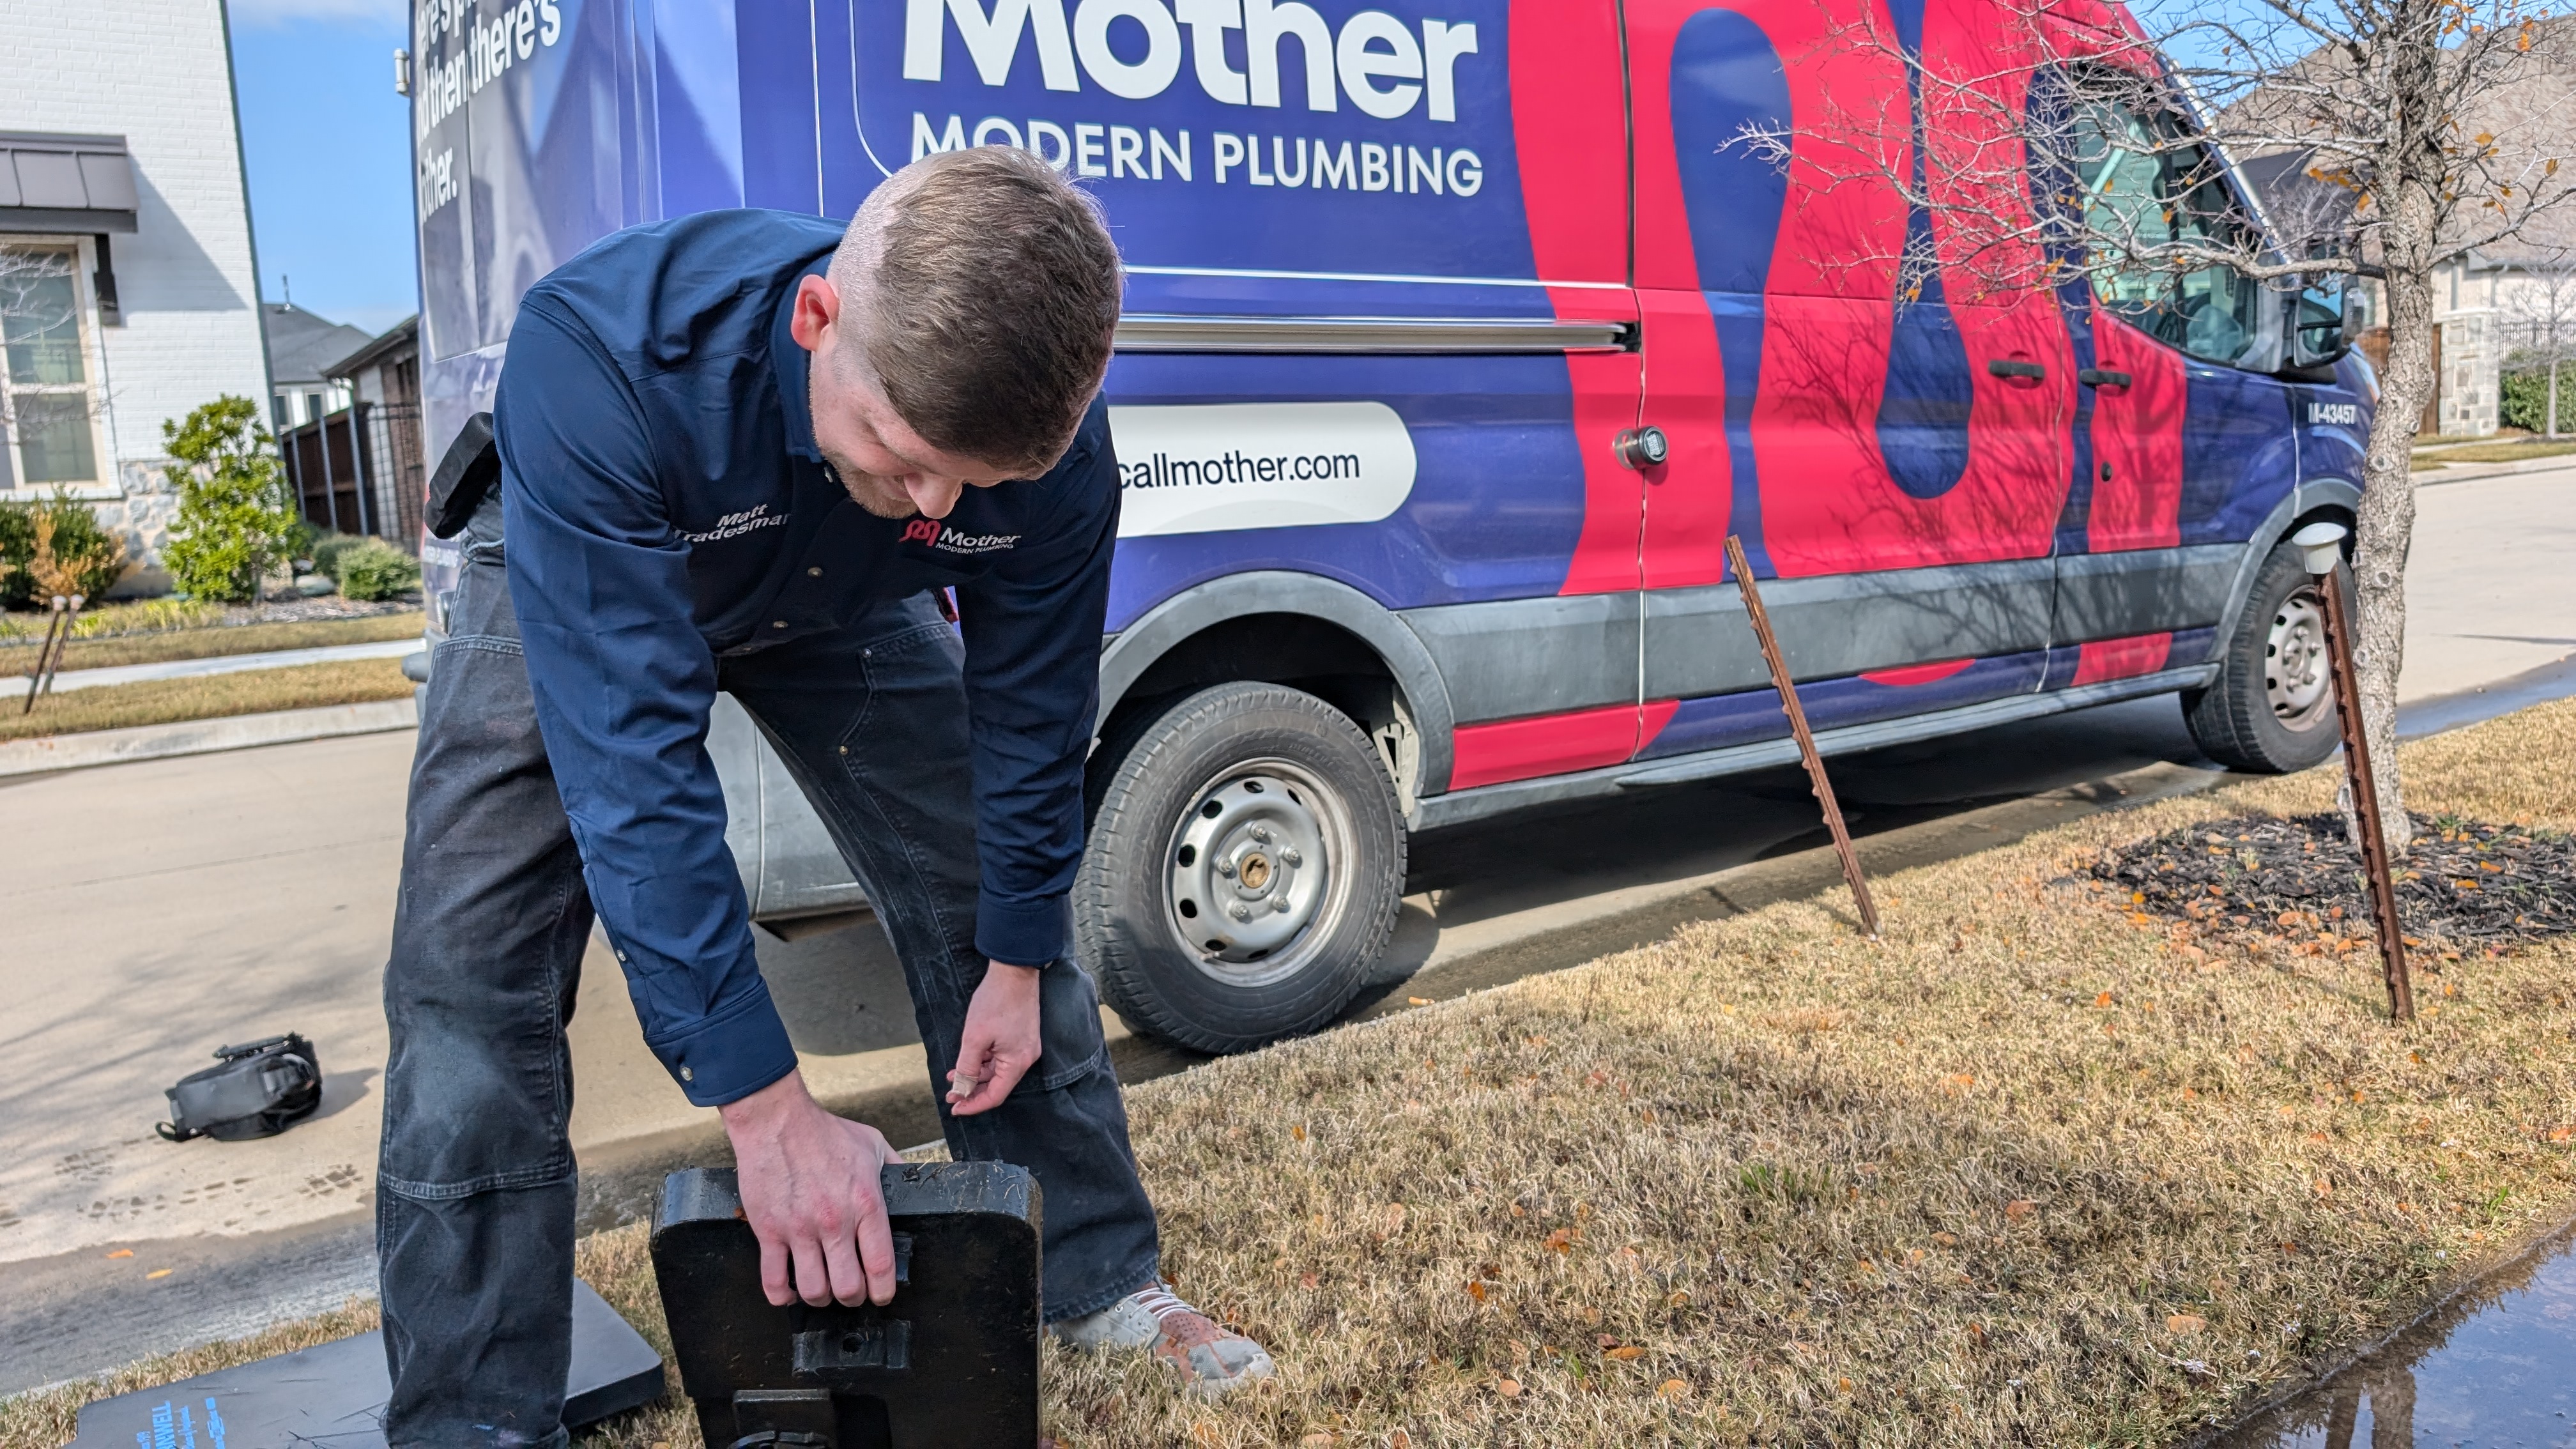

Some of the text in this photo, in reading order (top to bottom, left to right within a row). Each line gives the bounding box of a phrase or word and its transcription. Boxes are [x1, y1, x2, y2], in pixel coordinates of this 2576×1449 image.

[903, 0, 1477, 122] Mother
[429, 49, 470, 128] then
[911, 111, 1483, 197] MODERN PLUMBING
[2308, 402, 2356, 424] M-43457
[1119, 450, 1361, 489] callmother.com
[717, 503, 769, 528] Matt
[935, 542, 1014, 554] MODERN PLUMBING
[940, 527, 1022, 547] Mother
